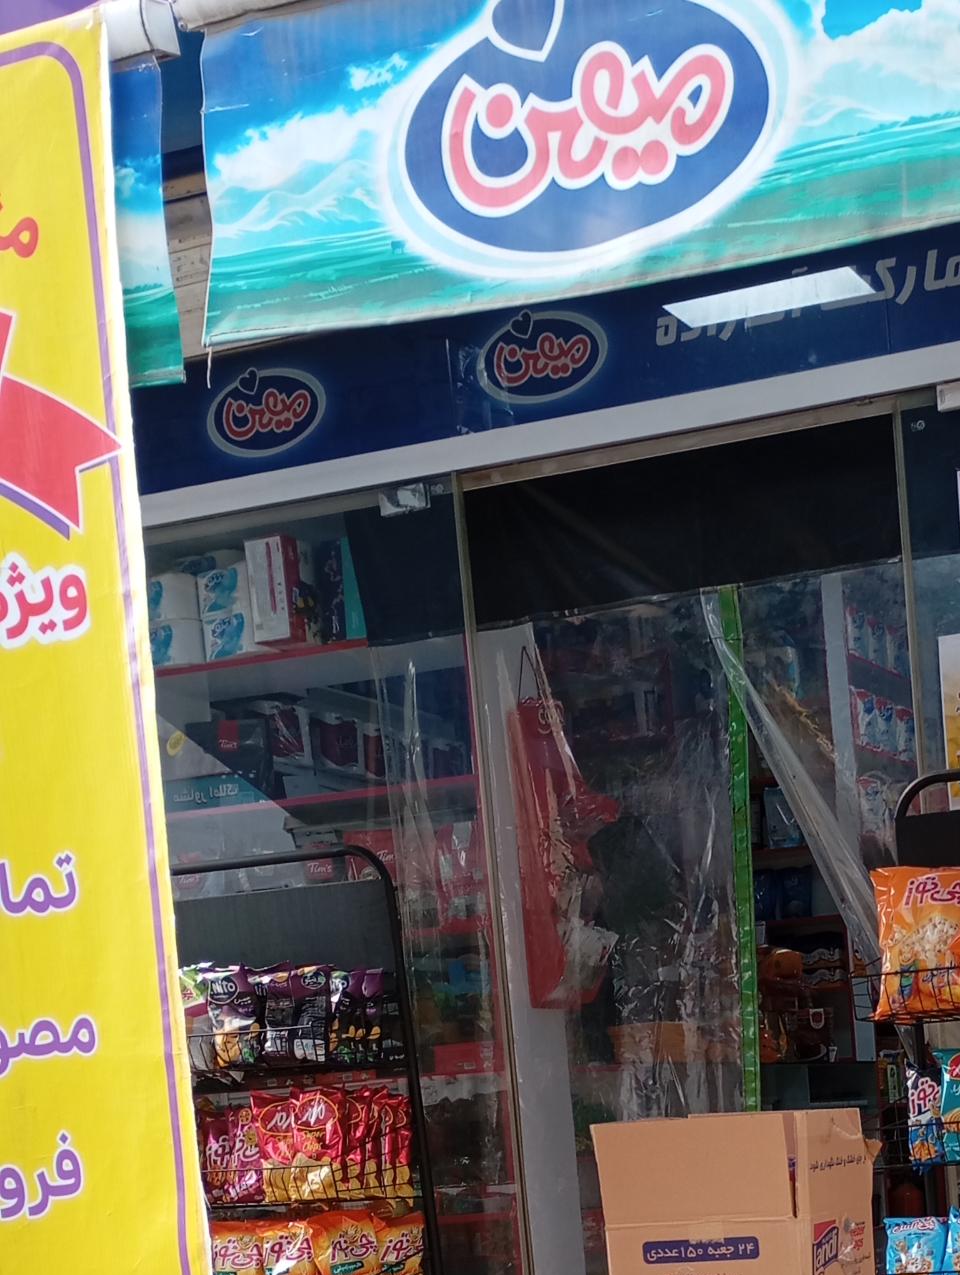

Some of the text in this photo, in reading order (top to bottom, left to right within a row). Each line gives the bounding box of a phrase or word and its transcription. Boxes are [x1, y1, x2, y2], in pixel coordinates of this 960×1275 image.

[443, 41, 733, 217] میهن
[494, 331, 589, 384] میهن
[223, 388, 310, 441] میهن
